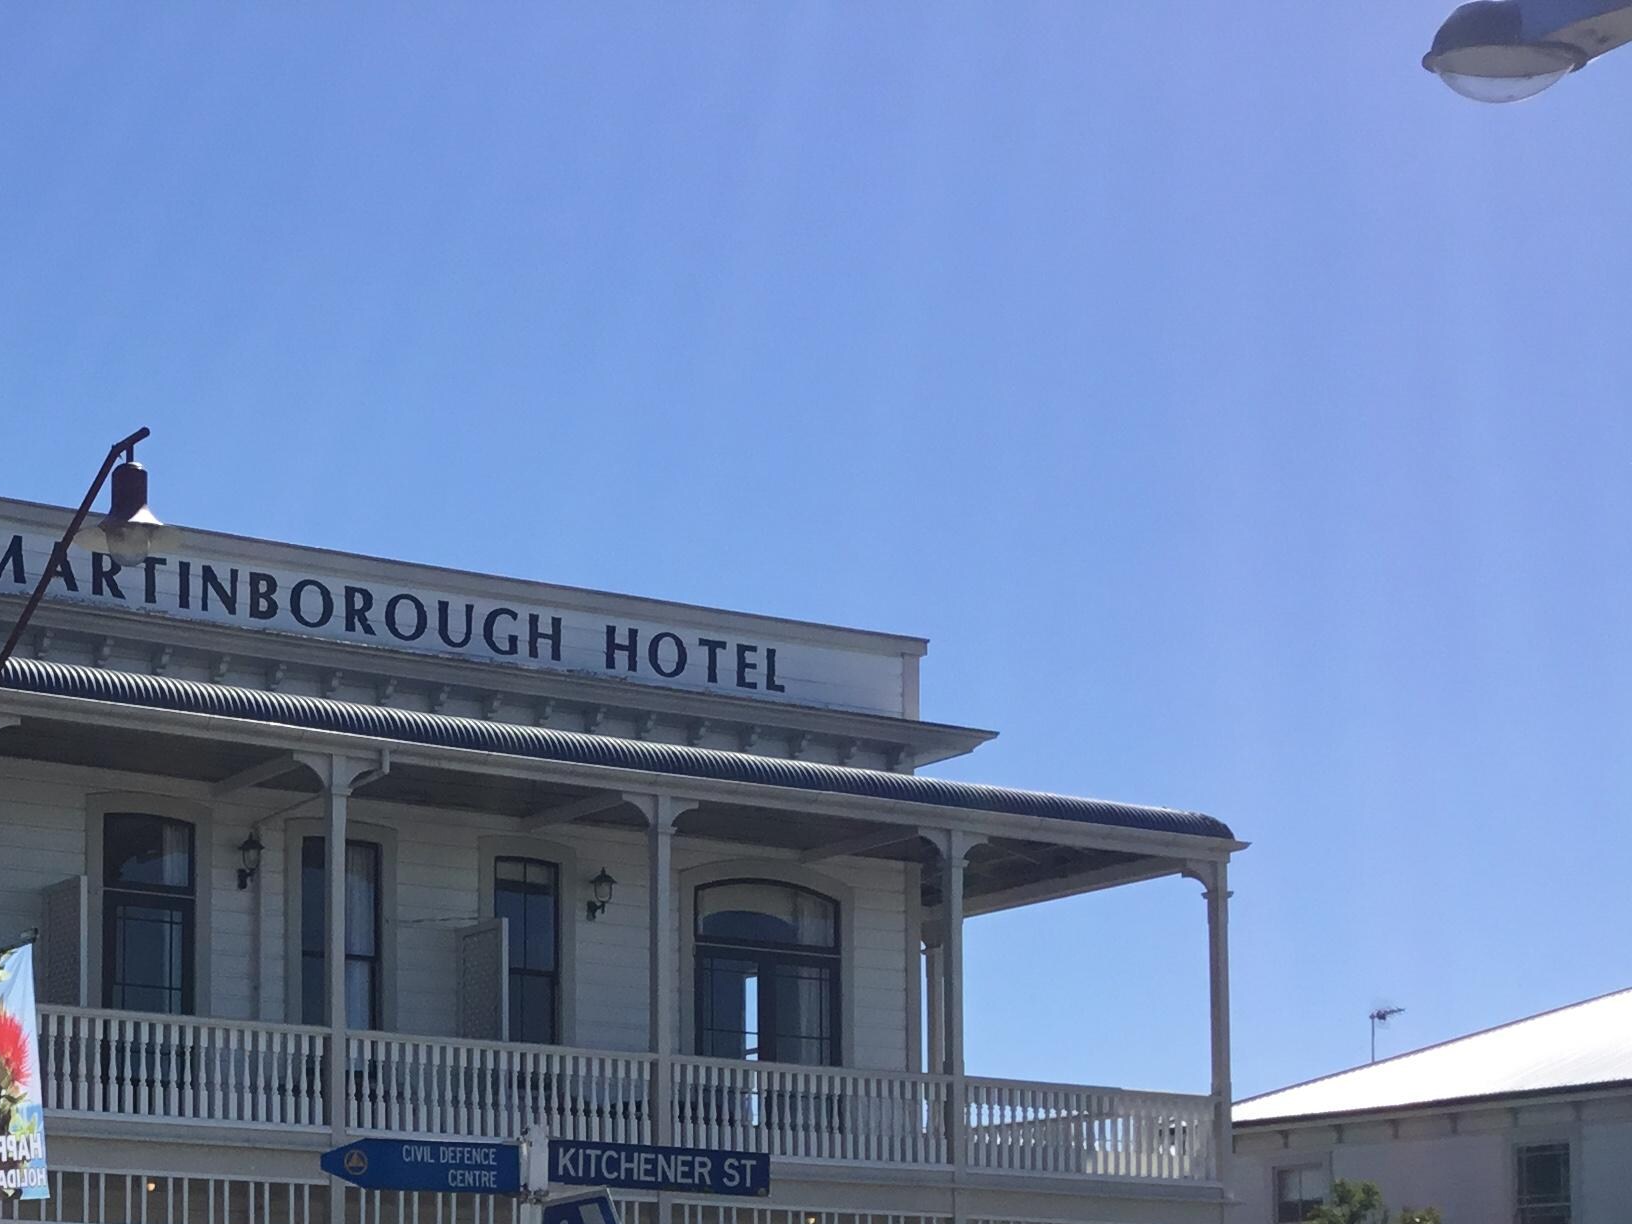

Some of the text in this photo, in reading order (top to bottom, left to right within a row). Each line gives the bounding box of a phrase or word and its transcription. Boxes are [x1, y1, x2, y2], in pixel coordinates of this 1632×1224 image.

[604, 626, 786, 694] HOTEL
[402, 1144, 497, 1166] CIVIL DEFENCE
[558, 1147, 757, 1188] KITCHENER ST
[448, 1170, 497, 1189] CENTRE
